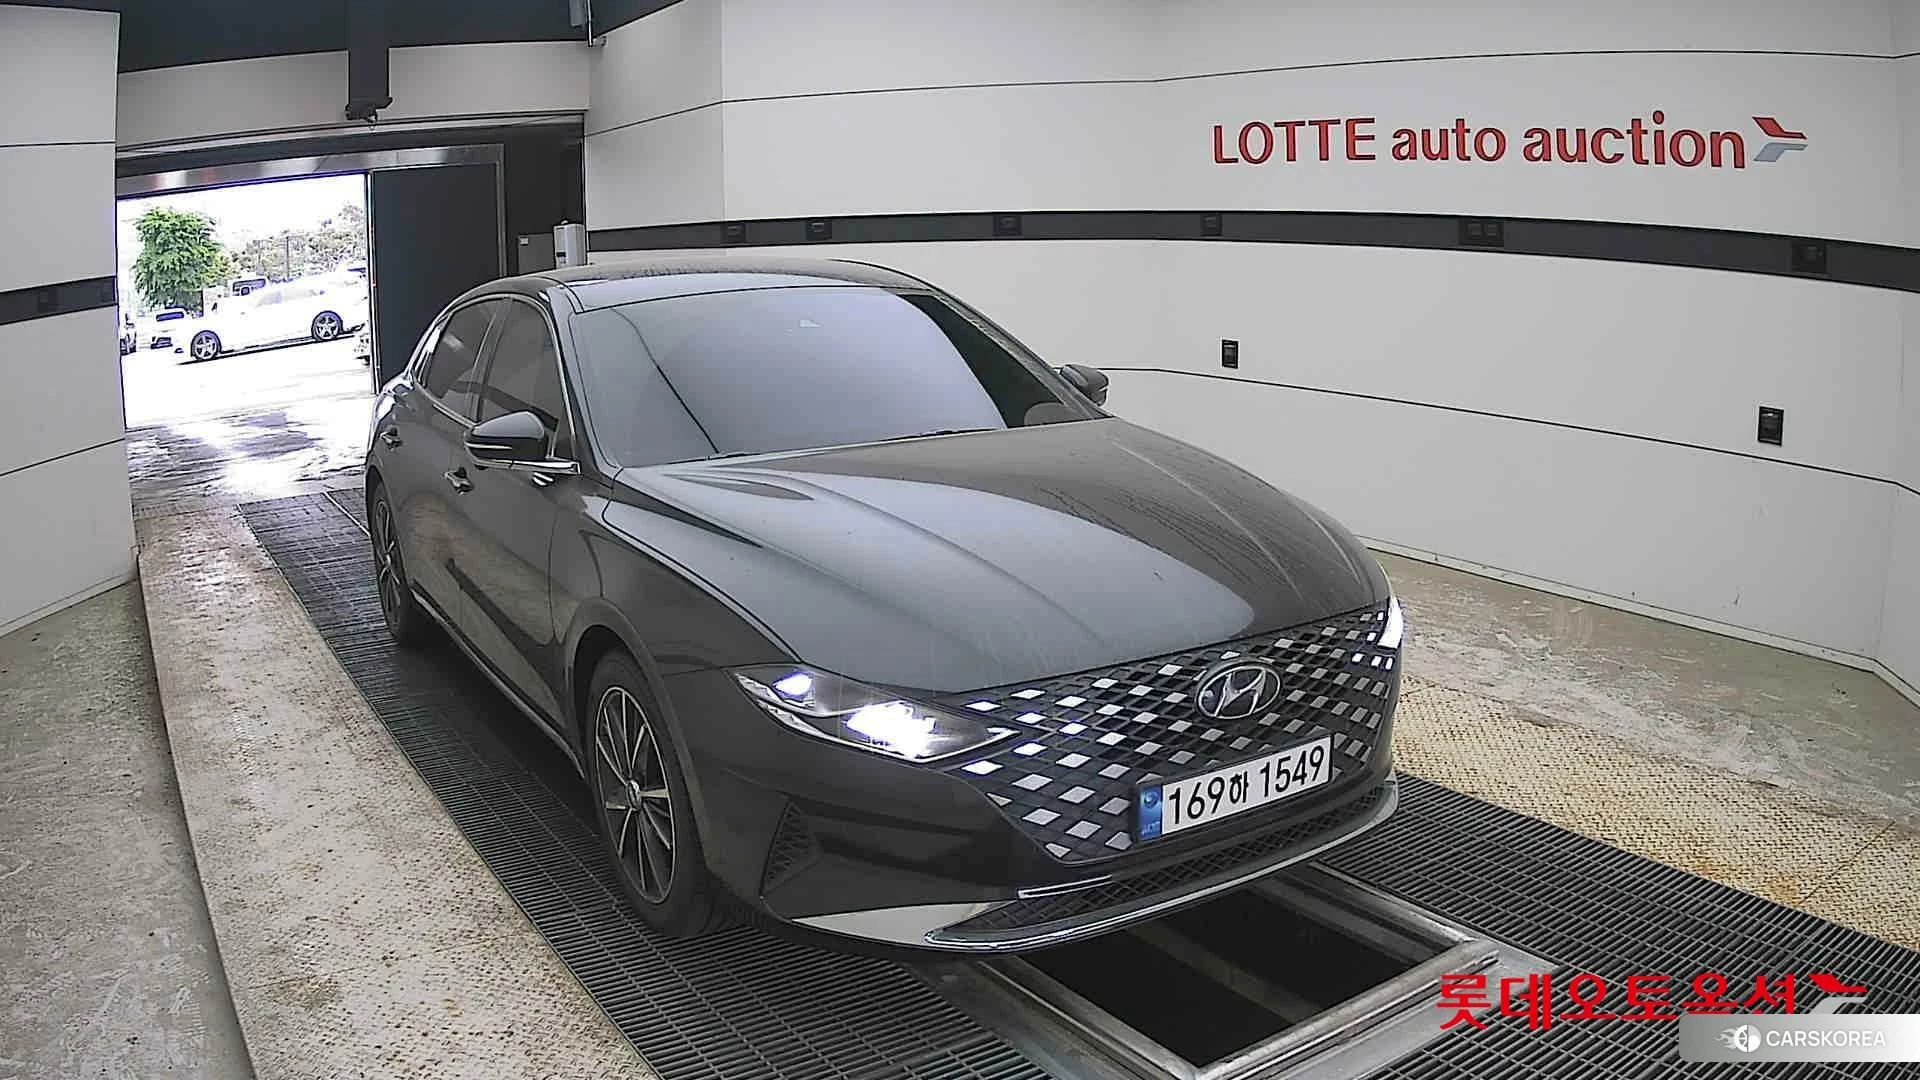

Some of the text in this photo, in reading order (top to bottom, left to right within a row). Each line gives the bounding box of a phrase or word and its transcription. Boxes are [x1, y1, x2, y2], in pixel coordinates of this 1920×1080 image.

[1212, 110, 1746, 169] LOTTE auto auction
[1168, 745, 1325, 825] 169하 1549
